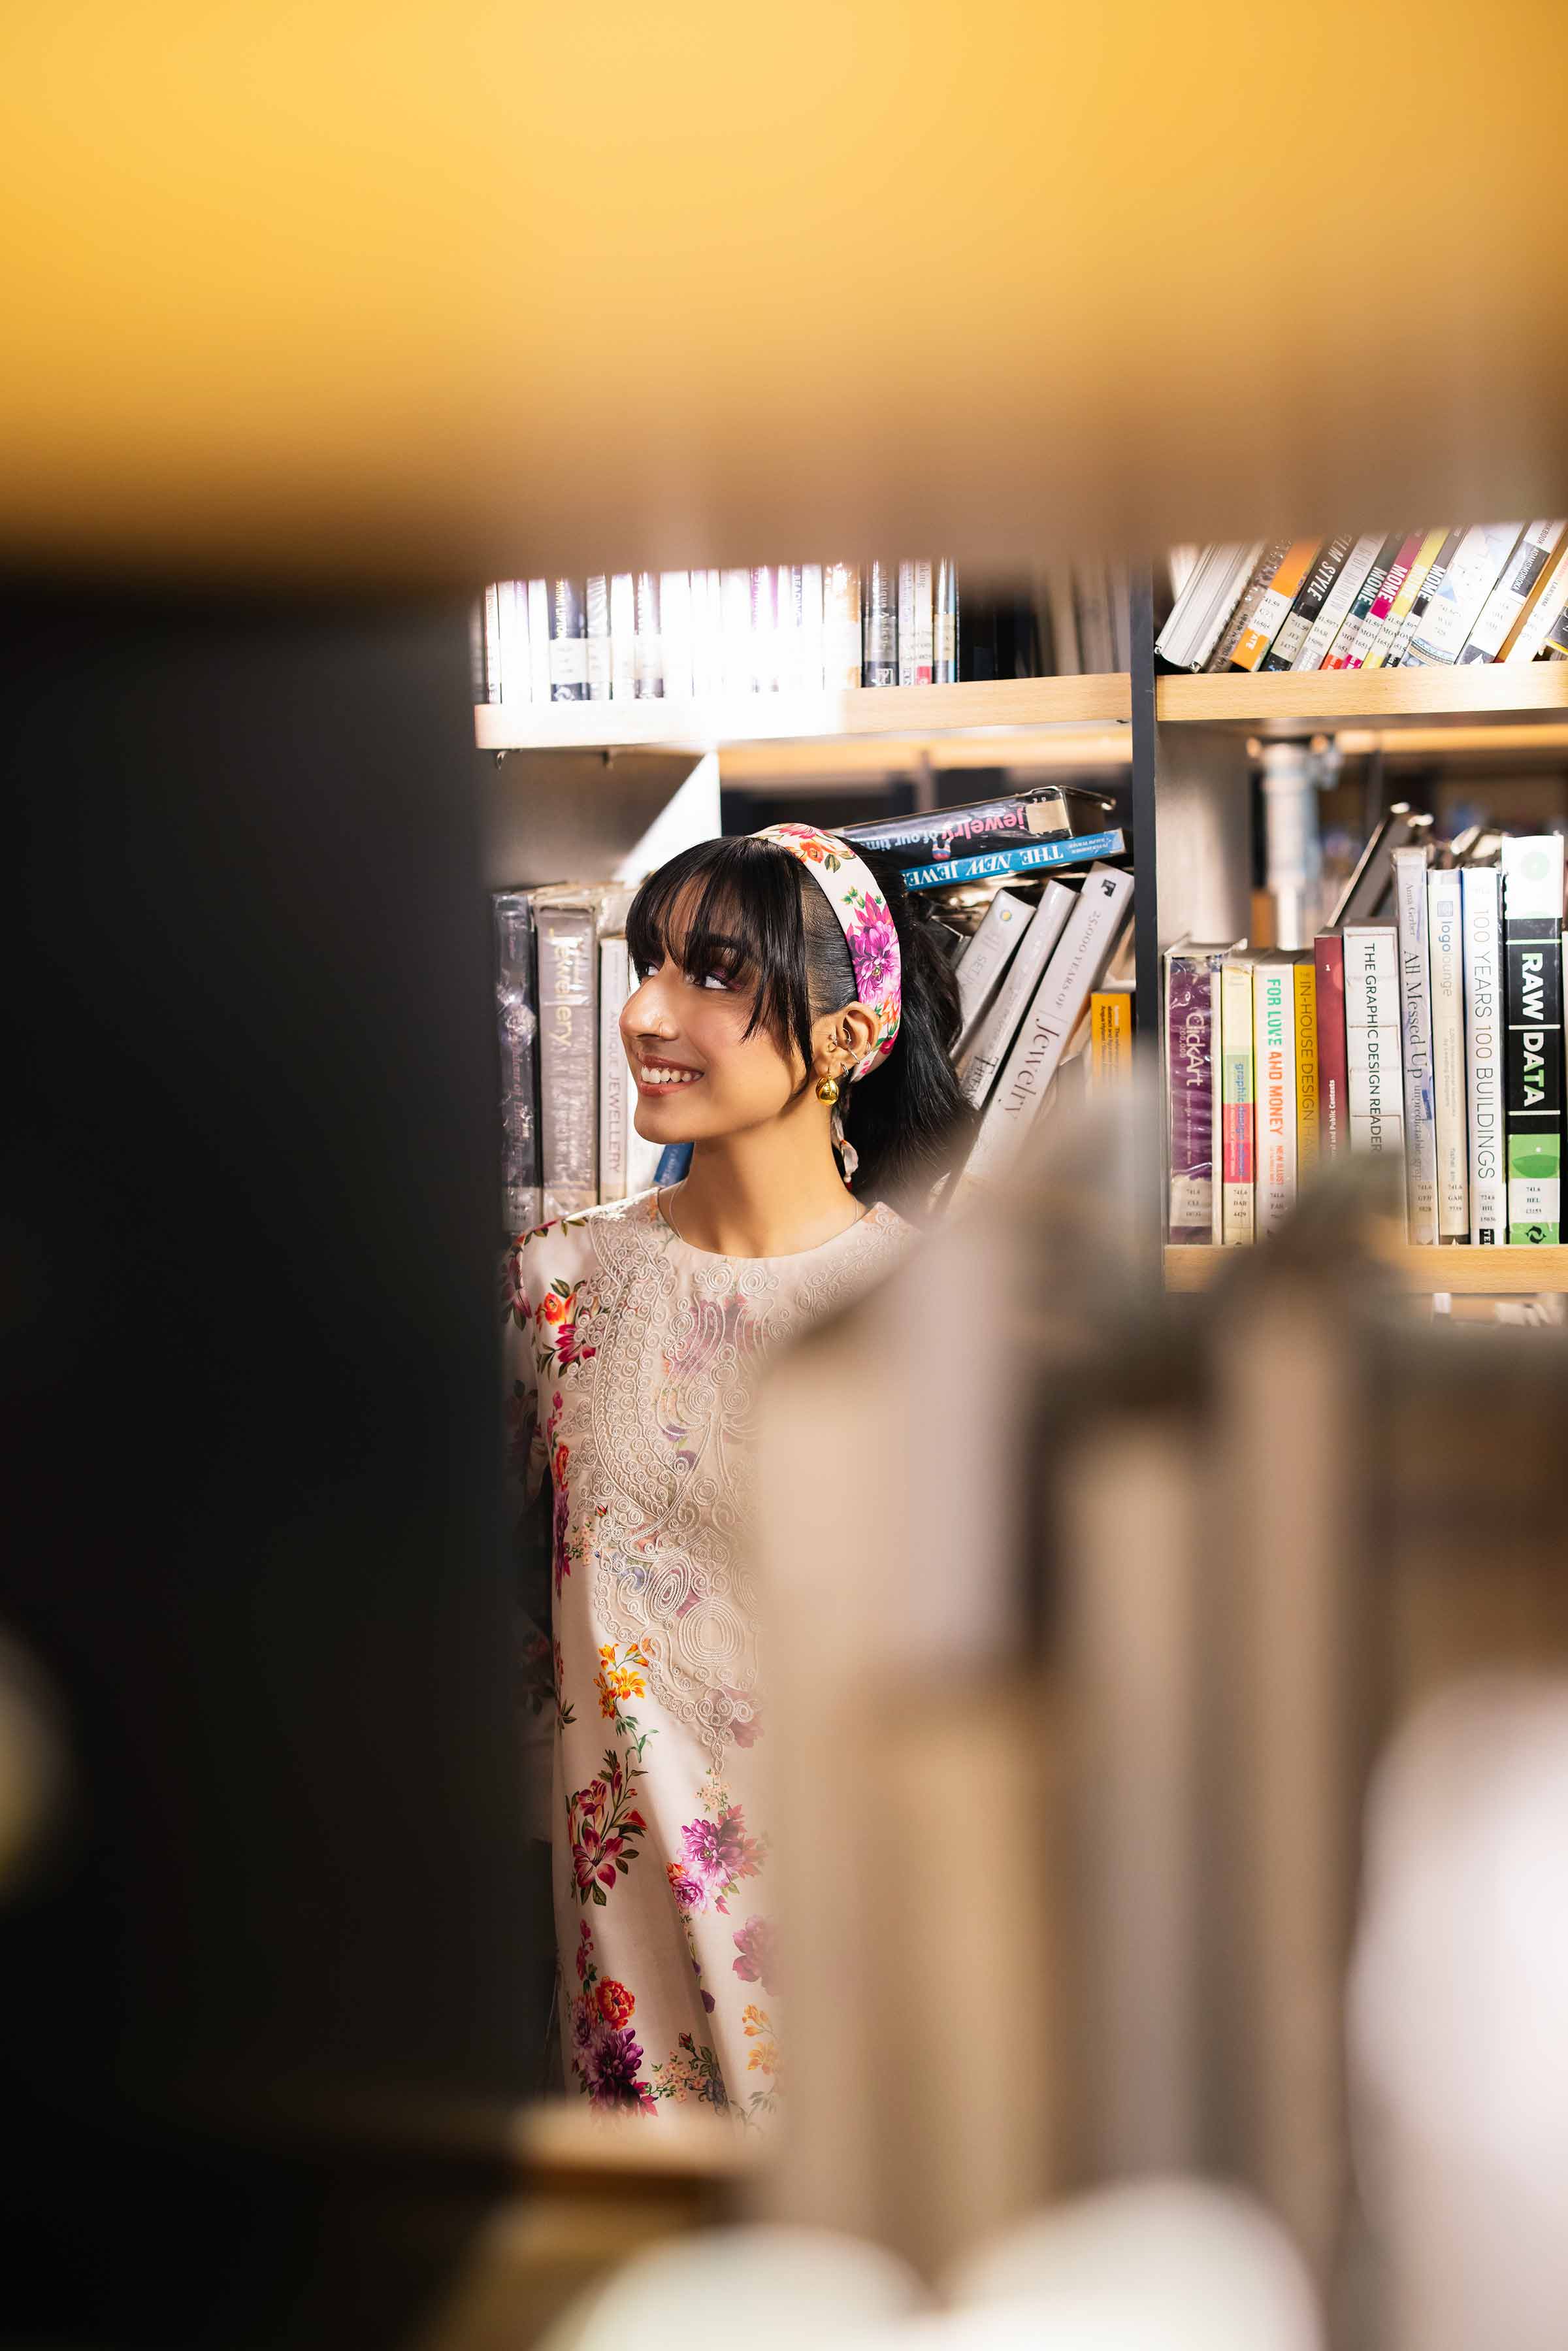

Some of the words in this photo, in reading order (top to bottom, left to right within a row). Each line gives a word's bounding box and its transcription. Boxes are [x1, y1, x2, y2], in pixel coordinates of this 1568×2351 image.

[1307, 561, 1336, 602] STYLE
[1358, 567, 1388, 605] MOME
[1378, 564, 1408, 603] MOME
[1420, 564, 1446, 602] MOME
[861, 834, 891, 852] tim
[894, 831, 921, 847] our
[941, 807, 1025, 841] jewelry
[903, 861, 960, 887] JEWE
[964, 853, 1011, 876] NEW
[1019, 844, 1064, 866] THE
[1473, 910, 1490, 944] 100
[1364, 943, 1377, 972] THE
[1404, 951, 1421, 975] All
[1439, 920, 1454, 996] logolounge
[548, 929, 585, 1046] Jewellery
[1267, 978, 1282, 1007] FOR
[1474, 951, 1492, 1018] YEARS
[1521, 952, 1545, 1020] RAW
[1299, 980, 1315, 1059] IN-HOUSE
[1365, 974, 1379, 1039] GRAPHIC
[1406, 981, 1426, 1046] Messed
[608, 1010, 619, 1067] ANTIQUE
[1267, 1010, 1282, 1046] LOVE
[1475, 1024, 1493, 1059] 100
[1004, 1017, 1062, 1120] Jewelry
[1185, 1012, 1205, 1087] ClickArt
[1268, 1051, 1283, 1080] AND
[1367, 1043, 1380, 1094] DESIGN
[1407, 1051, 1428, 1079] Up
[1523, 1032, 1545, 1108] DATA
[967, 1054, 1000, 1108] TIFFAN
[1235, 1062, 1247, 1103] graphic
[1301, 1063, 1315, 1121] DESIGN
[1328, 1079, 1337, 1110] Contexts
[607, 1071, 621, 1174] JEWELLERY
[1269, 1085, 1284, 1136] MONEY
[1369, 1098, 1382, 1153] READER
[1413, 1085, 1425, 1155] unpredictable
[1476, 1067, 1495, 1179] BUILDINGS
